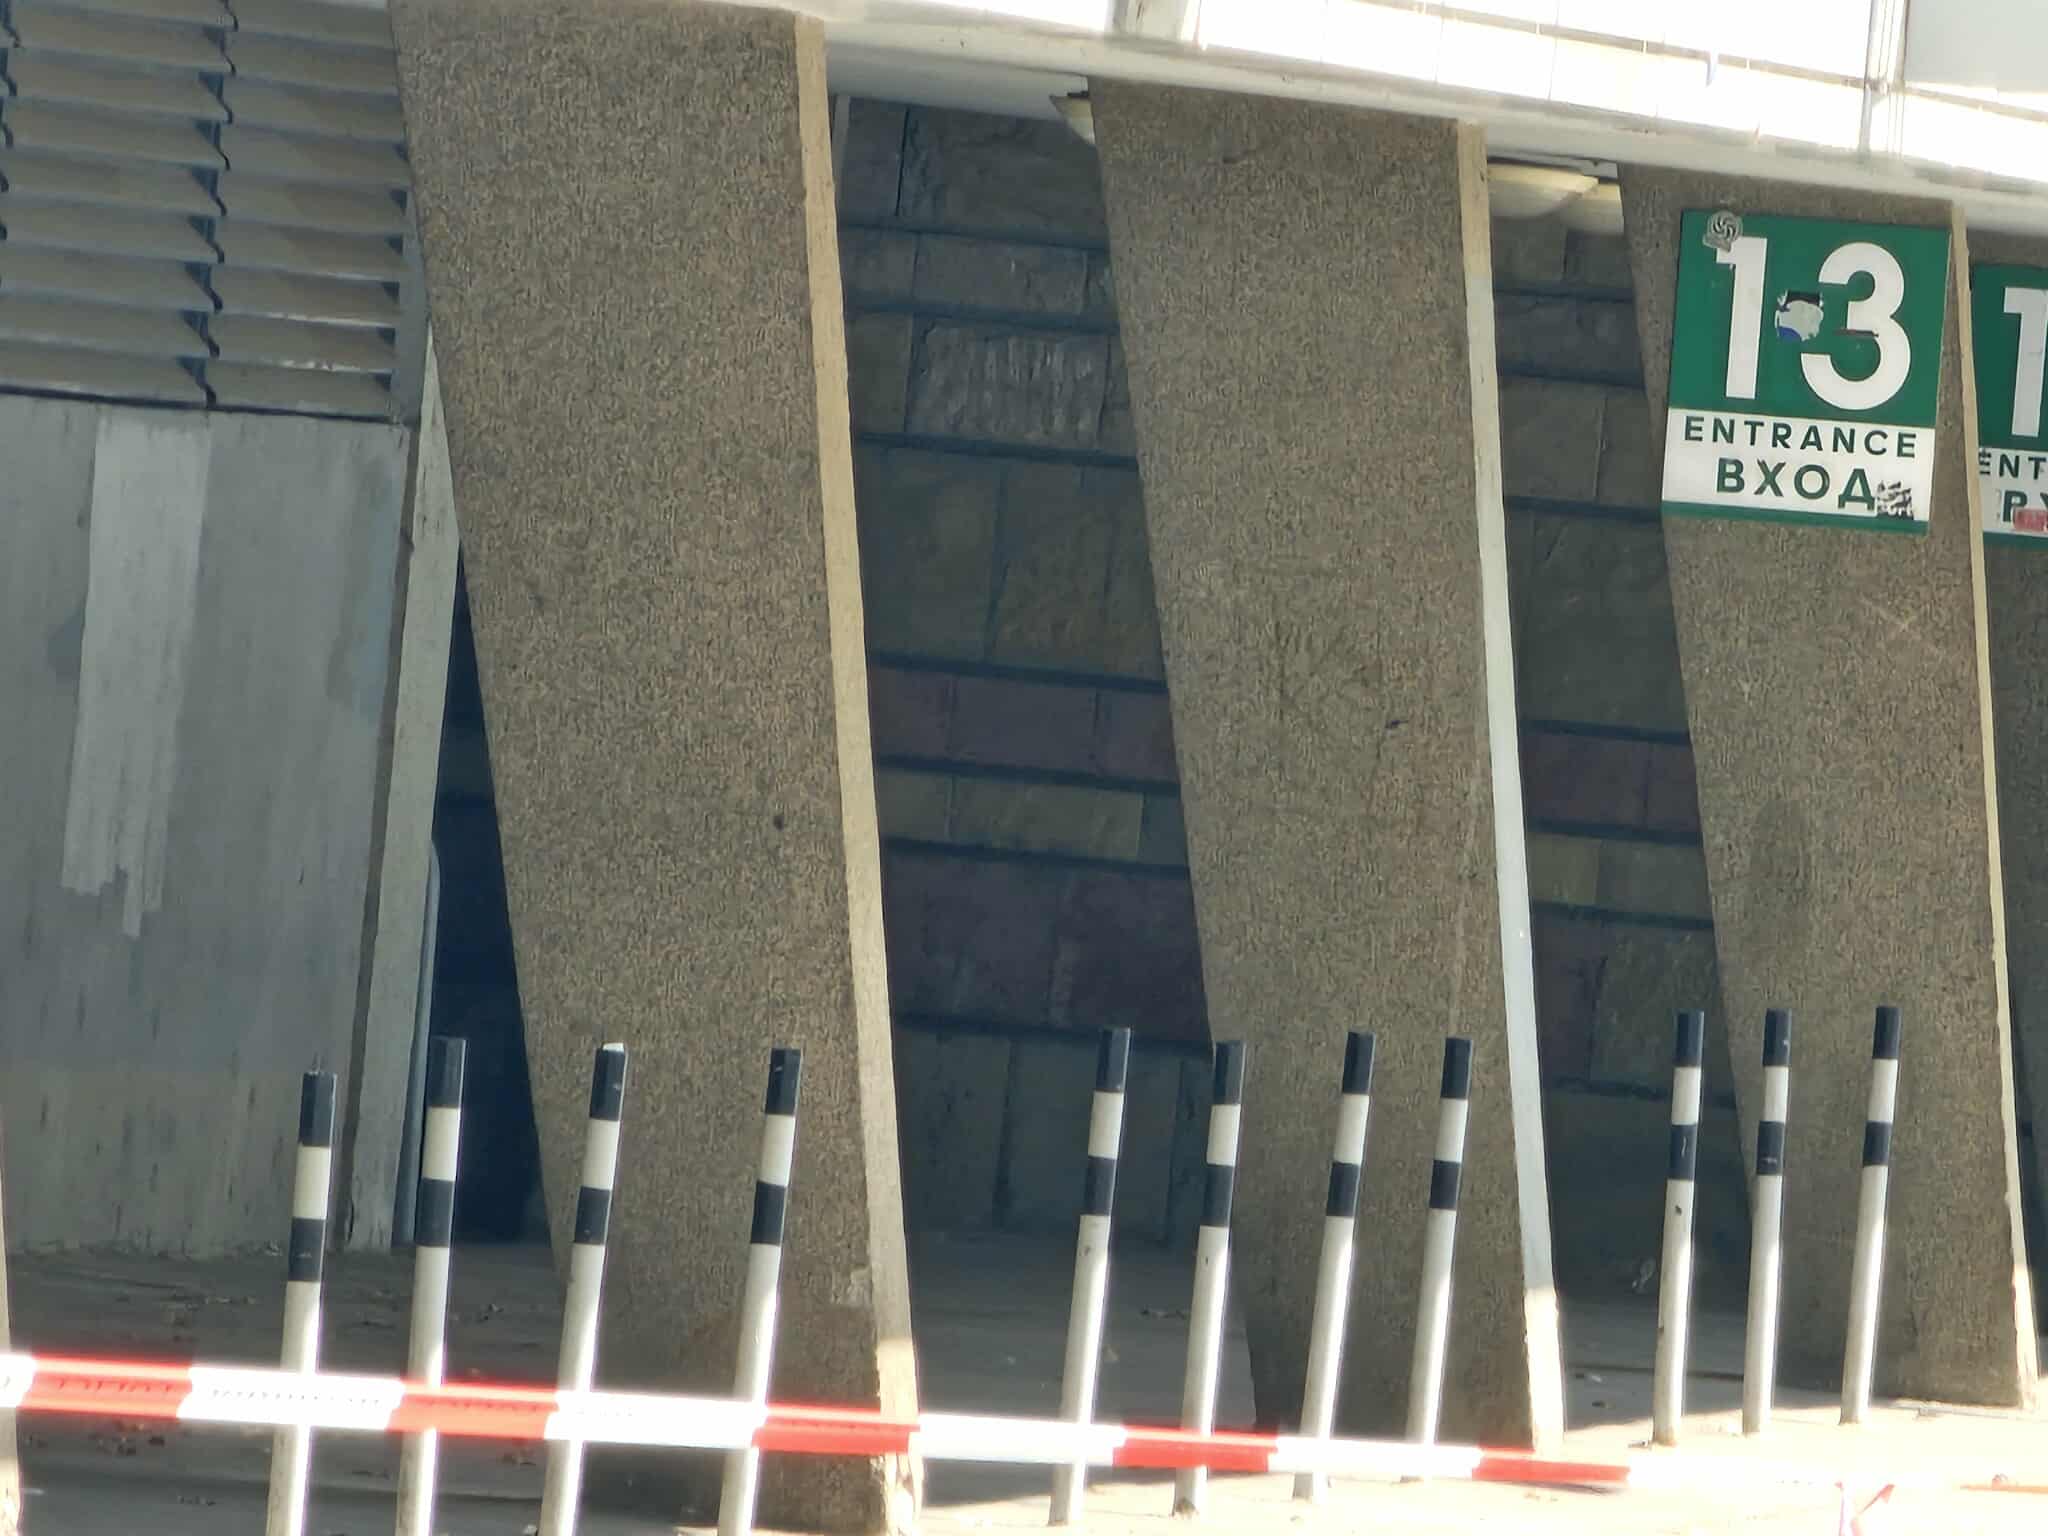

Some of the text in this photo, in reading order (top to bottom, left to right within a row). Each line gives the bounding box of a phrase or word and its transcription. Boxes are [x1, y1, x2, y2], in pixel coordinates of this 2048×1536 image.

[1716, 236, 1911, 411] 13
[1684, 415, 1917, 459] ENTRANCE
[1716, 457, 1875, 511] ВХОД
